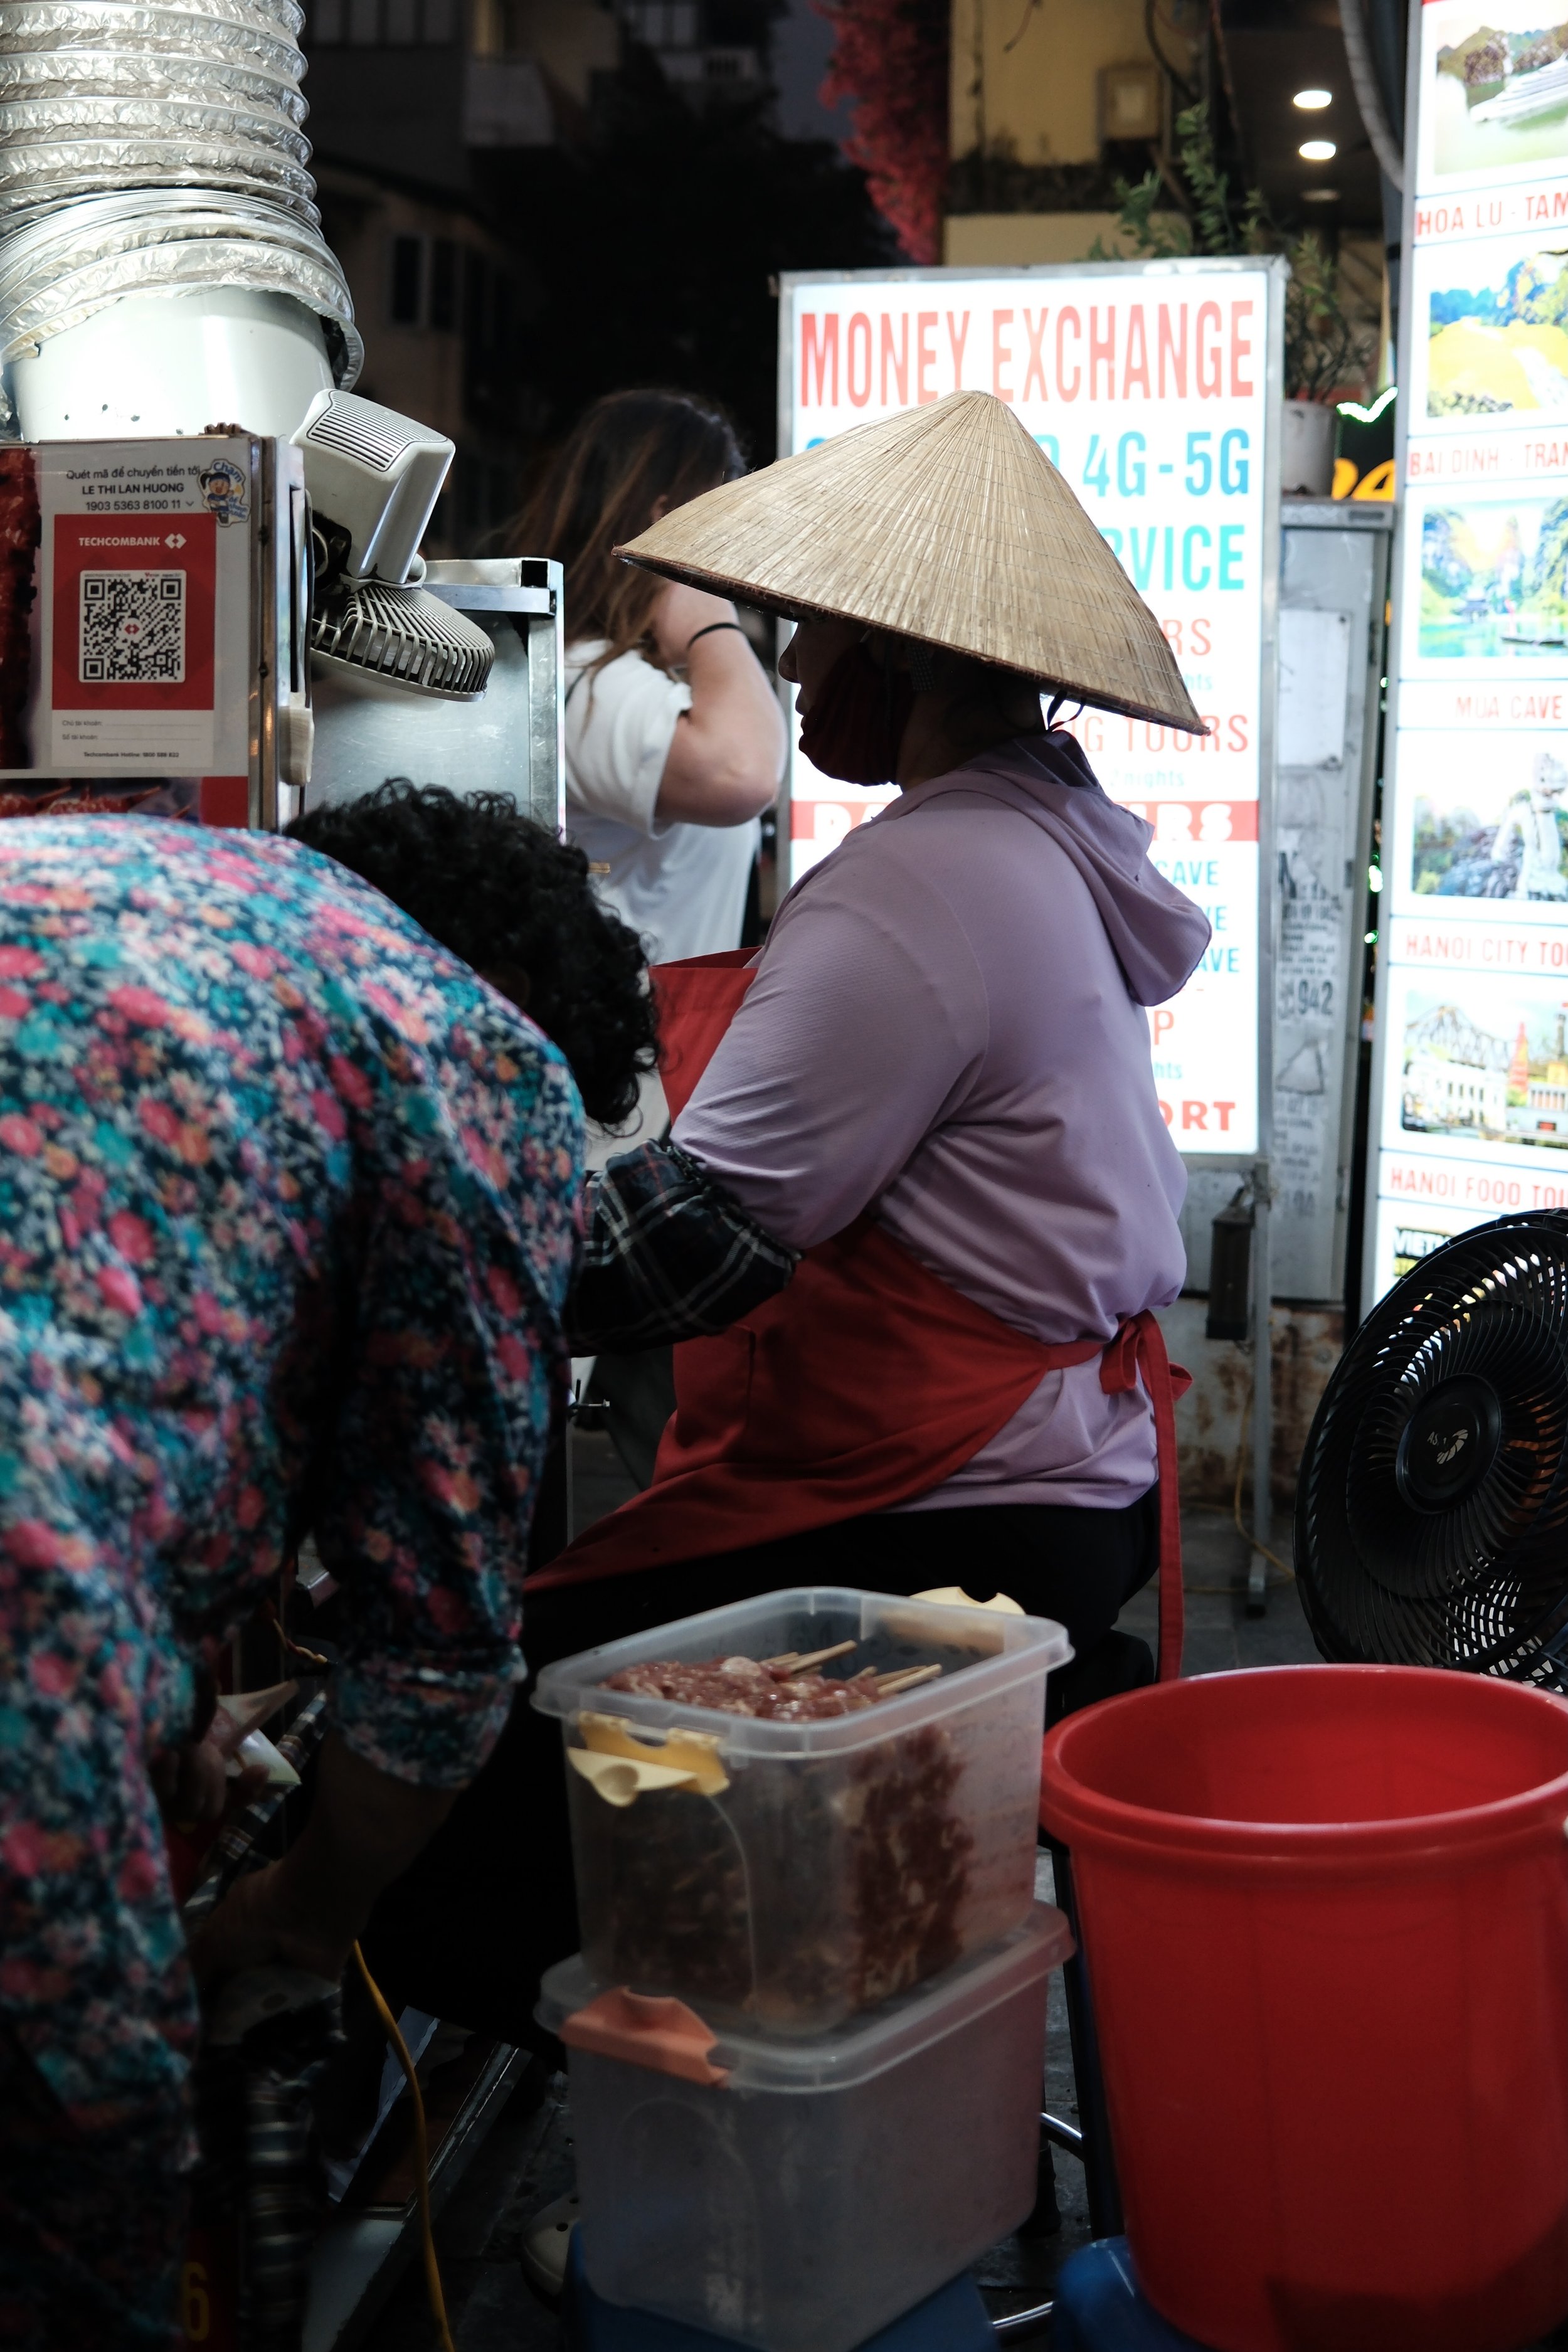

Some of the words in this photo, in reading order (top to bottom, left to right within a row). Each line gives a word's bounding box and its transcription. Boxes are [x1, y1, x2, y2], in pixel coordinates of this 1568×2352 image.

[1416, 206, 1465, 237] HOA
[1476, 201, 1502, 228] LU
[801, 311, 970, 407] MONEY
[992, 300, 1254, 403] EXCHANGE
[66, 469, 90, 479] Quét
[93, 469, 109, 478] mã
[127, 465, 163, 480] chuyển
[1410, 451, 1442, 476] BAI
[82, 485, 95, 494] LE
[98, 485, 115, 494] THI
[119, 484, 140, 494] LAN
[144, 483, 184, 493] HUONG
[86, 502, 110, 511] 1903
[114, 501, 140, 511] 5363
[143, 501, 168, 509] 8100
[172, 499, 181, 509] 11
[79, 537, 161, 546] TECHCOMBANK
[1455, 696, 1500, 718] MUA
[1510, 695, 1562, 719] CAVE
[1406, 935, 1472, 960] HANOI
[1482, 938, 1528, 964] CITY
[1539, 941, 1568, 967] TO
[1391, 1167, 1456, 1197] HANOI
[1466, 1177, 1522, 1206] FOOD
